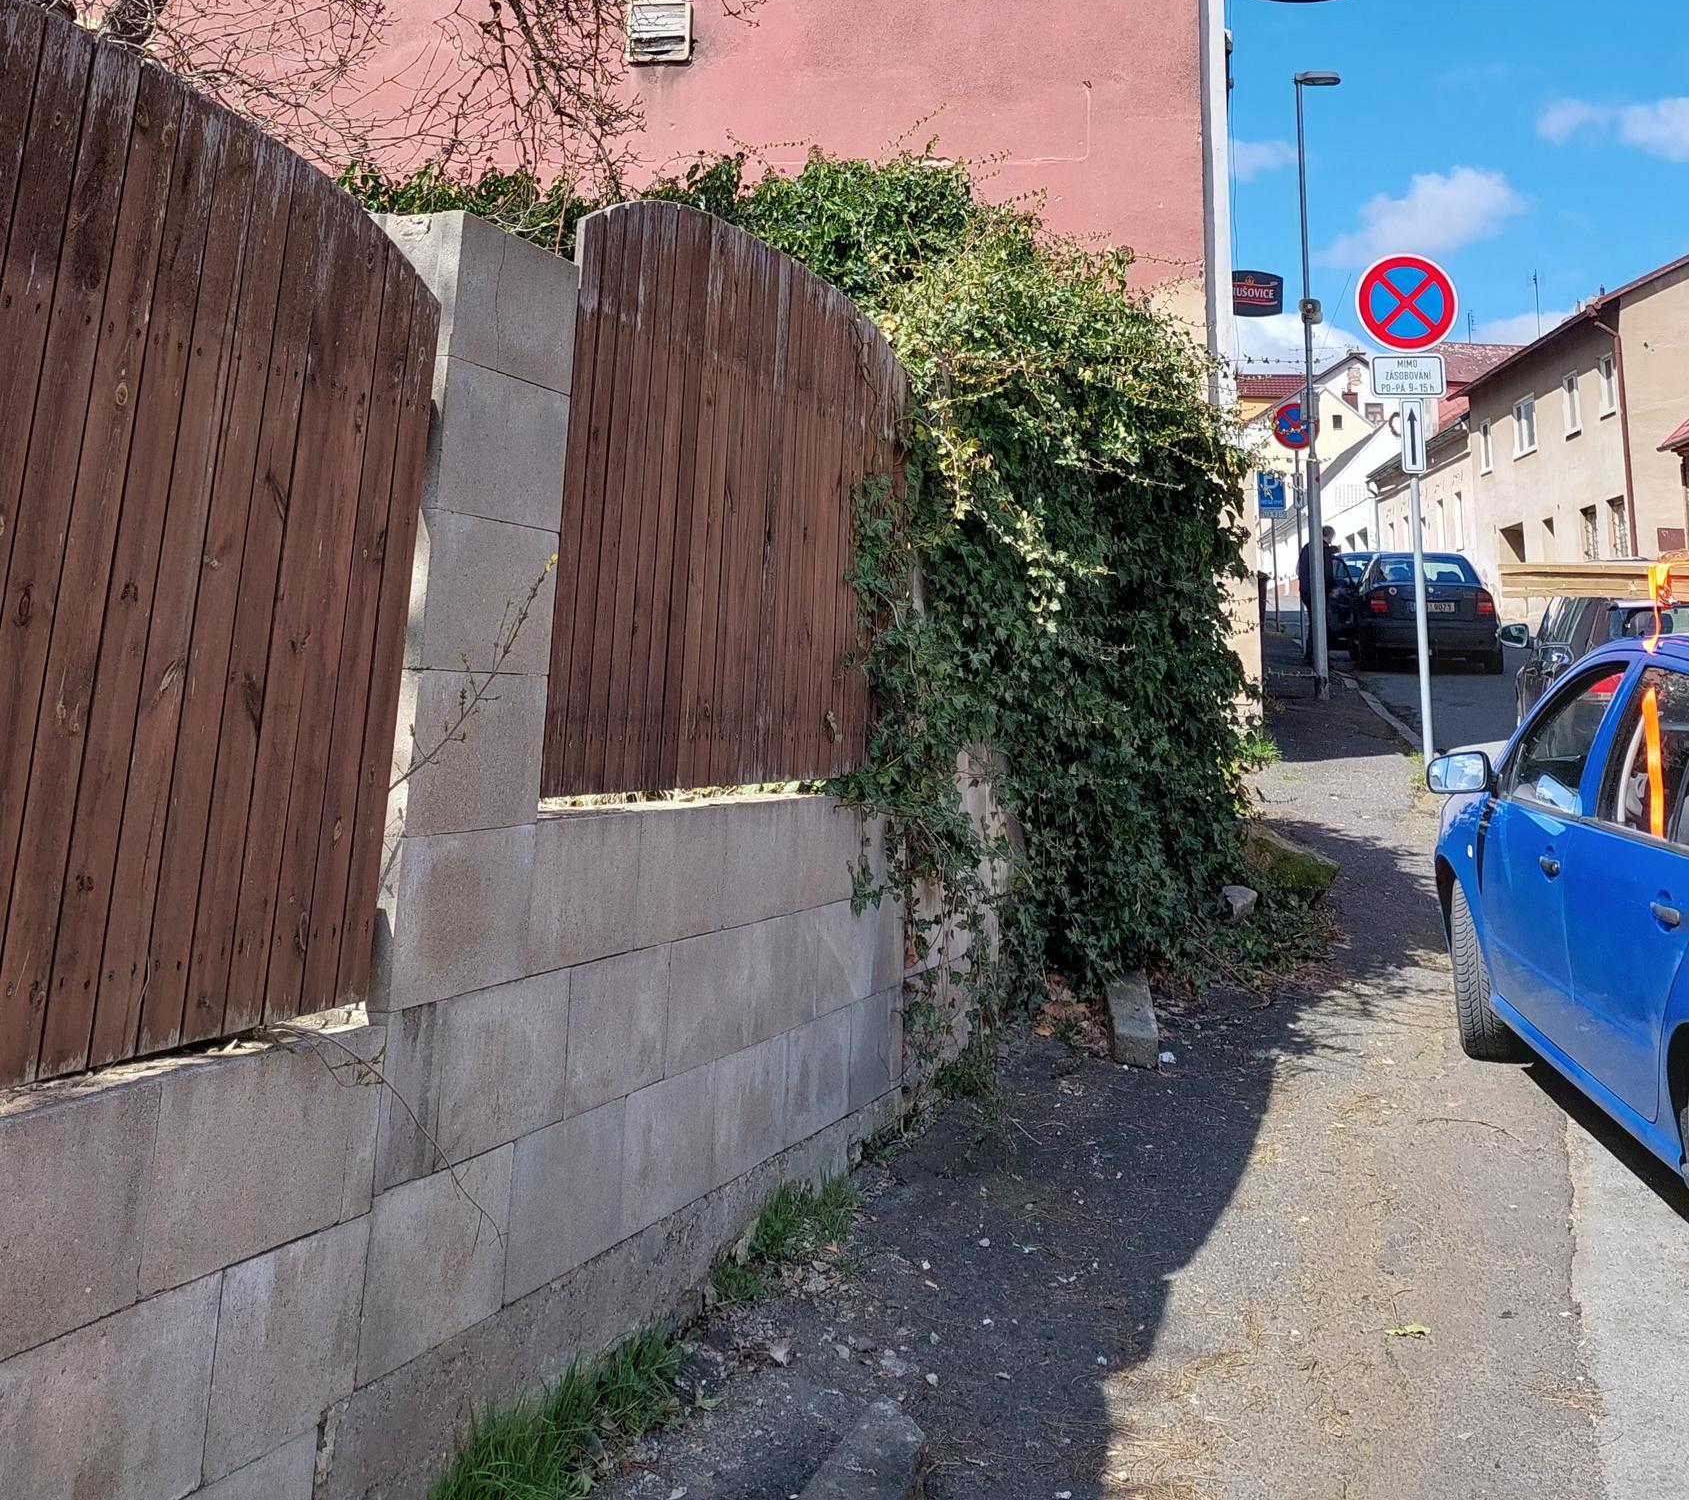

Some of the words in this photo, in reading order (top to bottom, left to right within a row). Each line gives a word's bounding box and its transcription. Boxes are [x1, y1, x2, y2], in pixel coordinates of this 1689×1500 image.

[1397, 360, 1418, 368] MIMO
[1385, 369, 1431, 380] ZÁSOBOVÁNÍ
[1381, 382, 1405, 392] PO-PÁ
